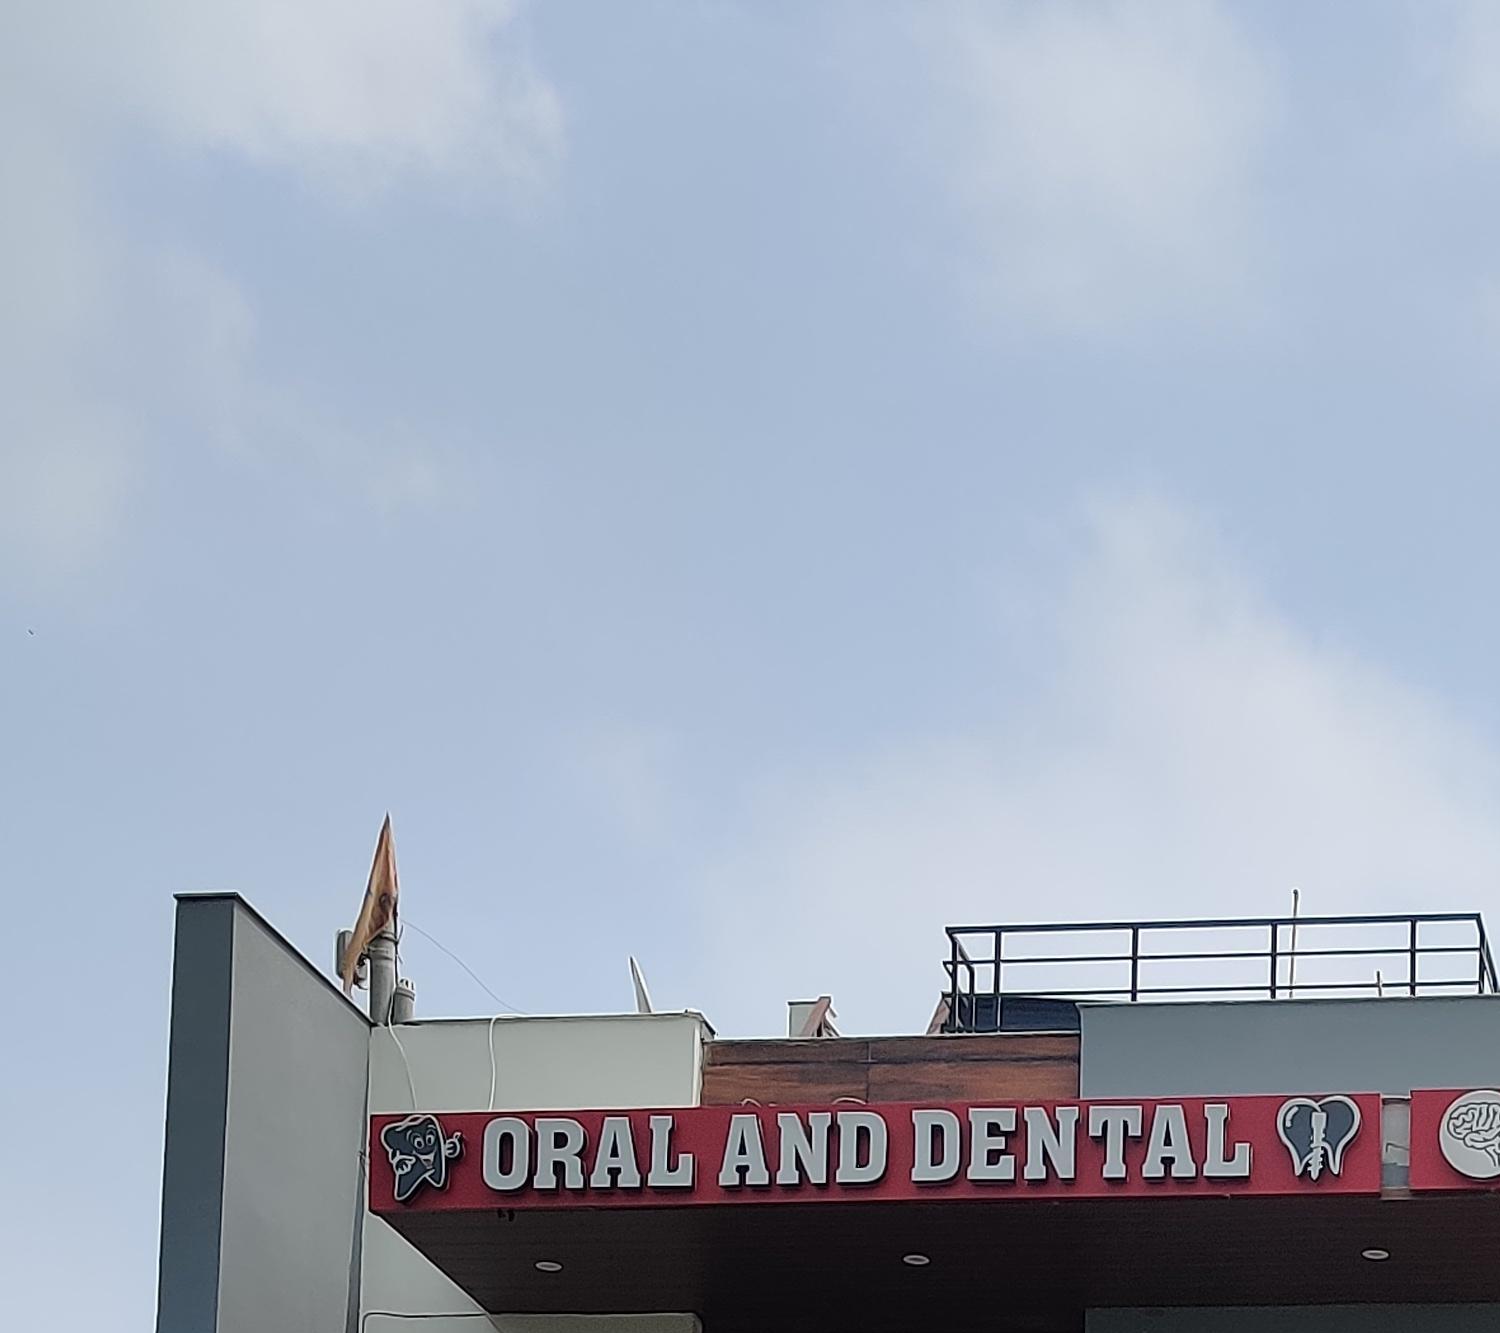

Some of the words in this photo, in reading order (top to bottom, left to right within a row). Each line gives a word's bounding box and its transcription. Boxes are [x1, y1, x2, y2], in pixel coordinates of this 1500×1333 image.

[481, 1114, 694, 1191] ORAL
[718, 1110, 887, 1187] AND
[910, 1103, 1250, 1184] DENTAL
